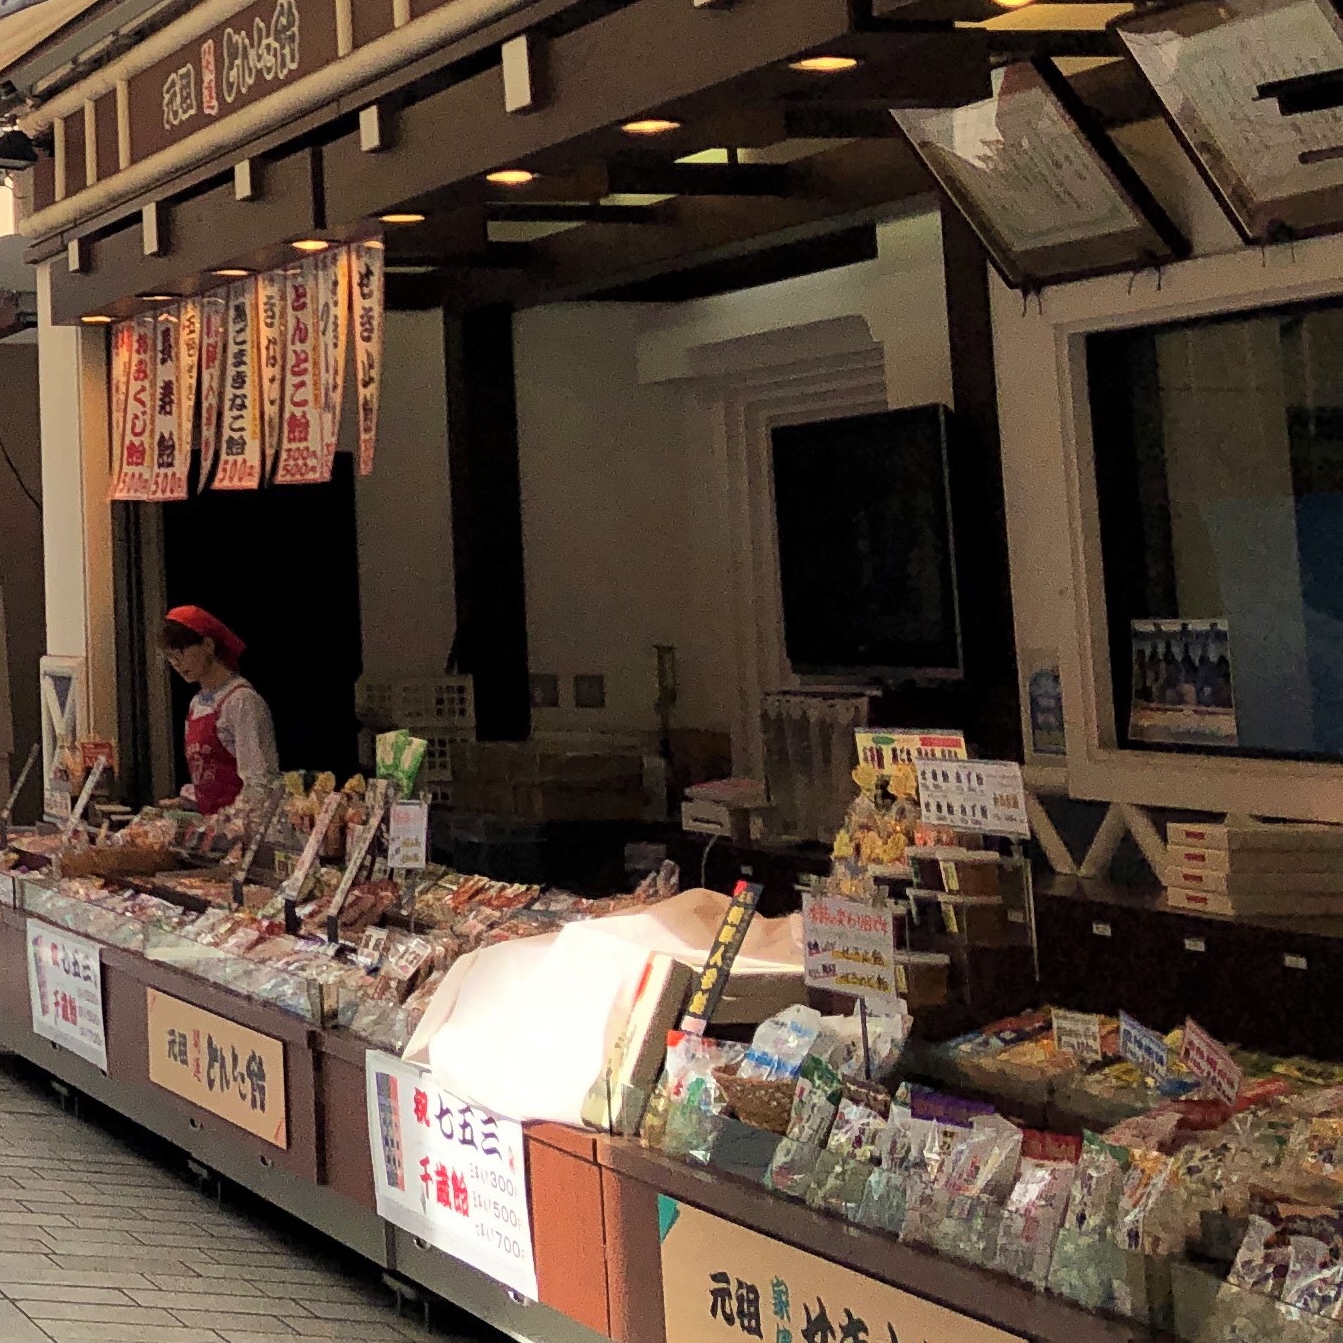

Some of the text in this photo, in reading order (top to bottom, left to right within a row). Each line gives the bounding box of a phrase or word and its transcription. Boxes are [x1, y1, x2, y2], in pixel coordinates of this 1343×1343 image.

[167, 1028, 189, 1067] 元祖
[207, 1033, 266, 1113] とんとこ飴
[434, 1093, 502, 1160] 七五三
[710, 1271, 763, 1341] 元祖
